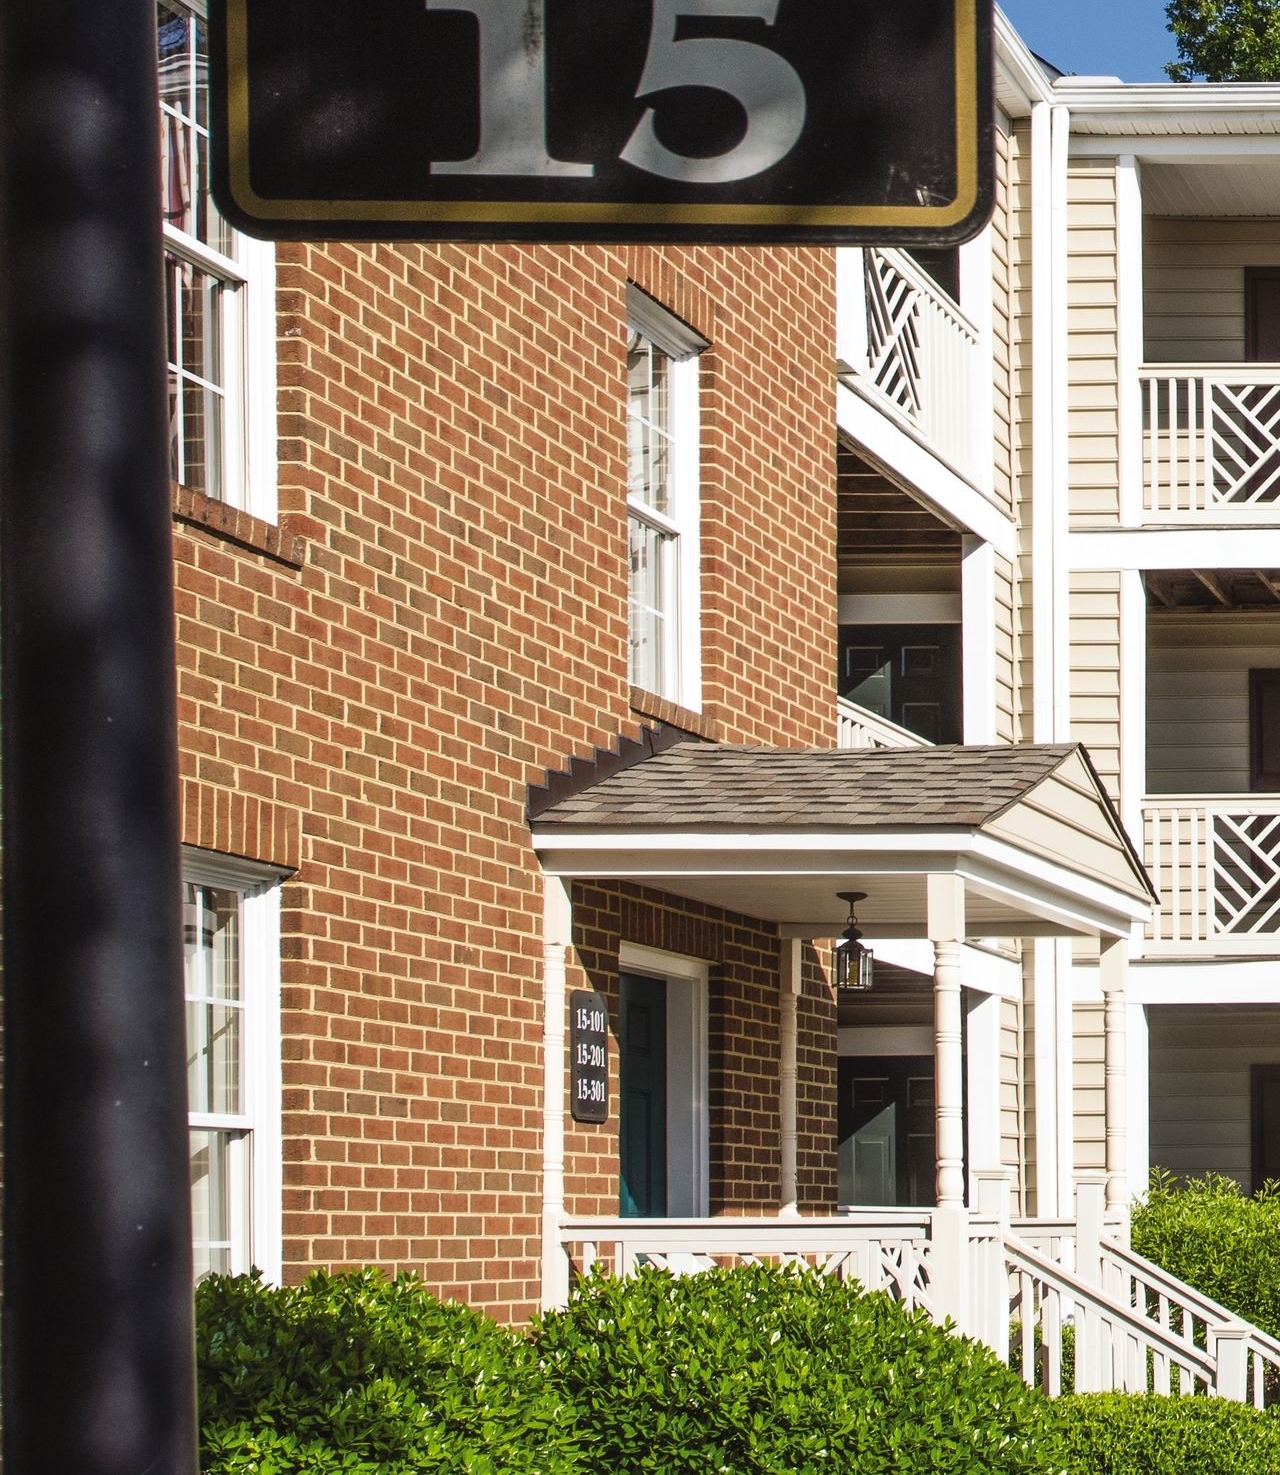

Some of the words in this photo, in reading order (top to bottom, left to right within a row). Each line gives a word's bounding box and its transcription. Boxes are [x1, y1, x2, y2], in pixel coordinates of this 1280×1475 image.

[576, 1007, 605, 1033] 15-101
[576, 1043, 606, 1068] 15-201
[576, 1078, 606, 1102] 15-301
